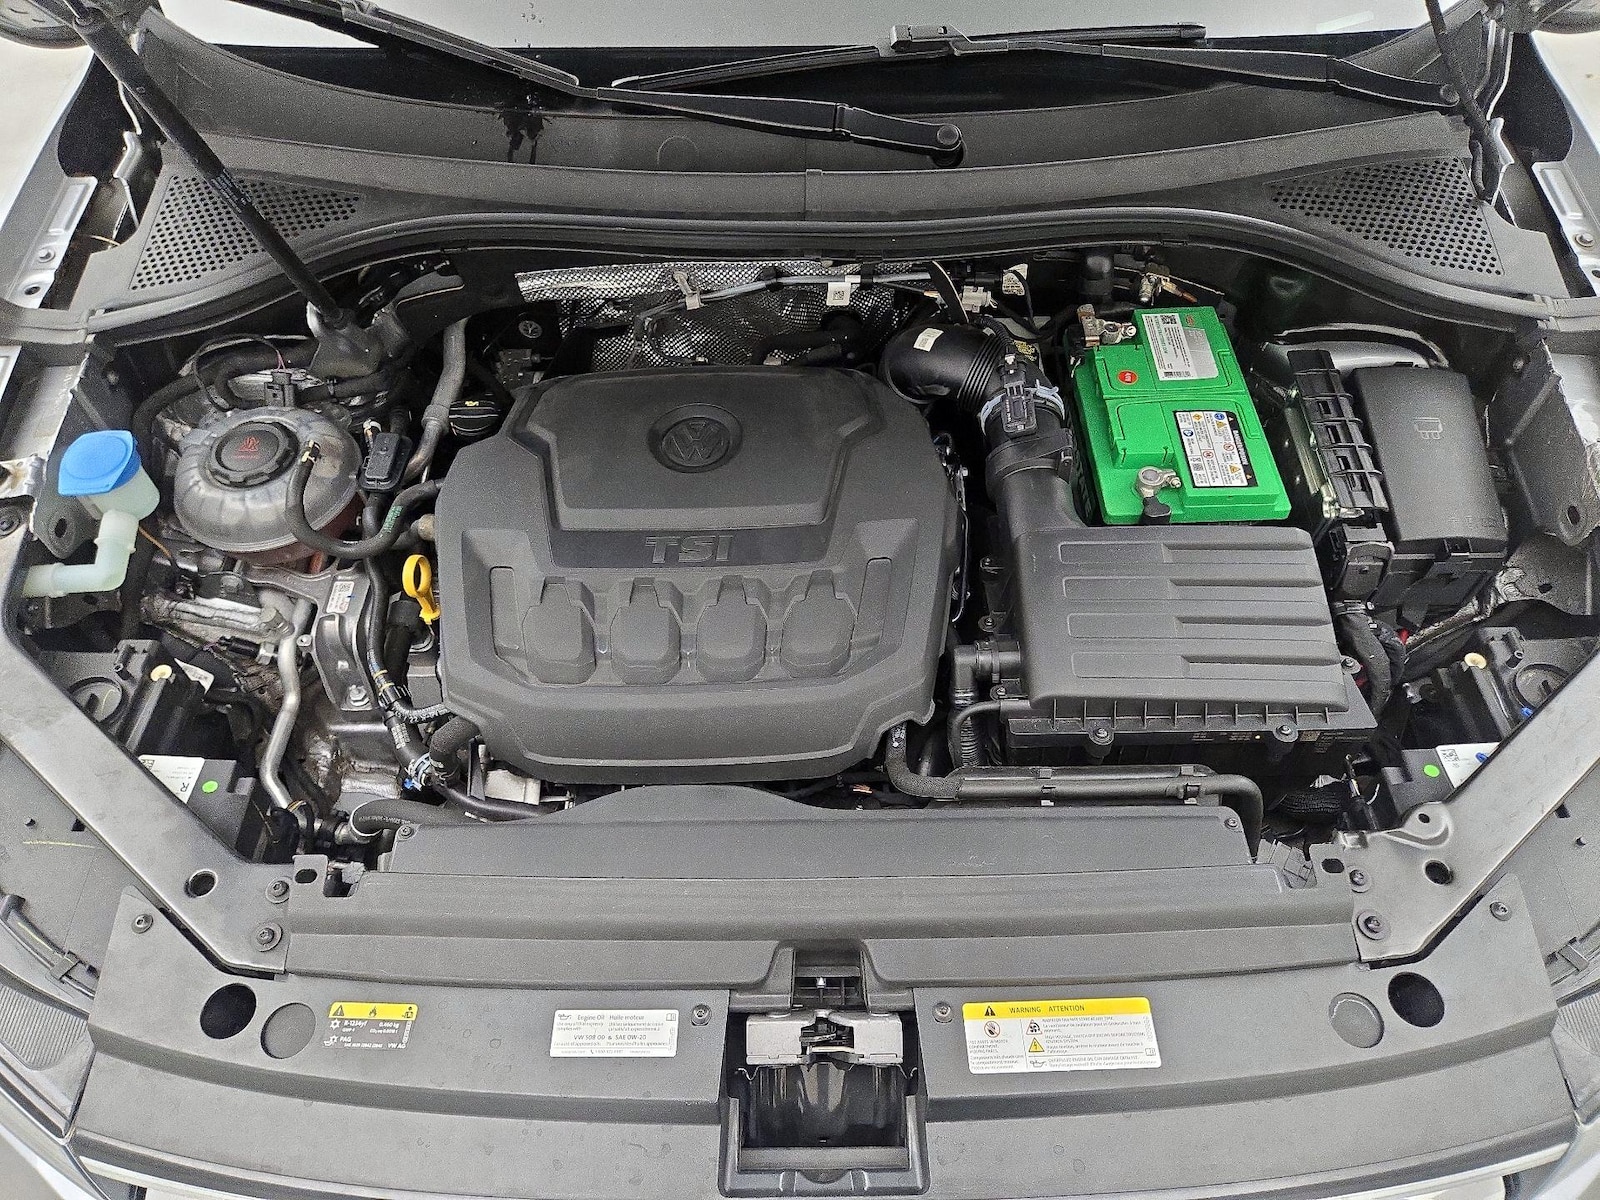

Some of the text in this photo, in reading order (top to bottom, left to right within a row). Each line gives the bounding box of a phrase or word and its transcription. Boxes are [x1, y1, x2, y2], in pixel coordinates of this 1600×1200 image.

[645, 535, 734, 564] TSI
[180, 782, 190, 793] R
[1009, 1004, 1085, 1014] WARNING ATTENTION
[577, 1014, 596, 1022] Engine
